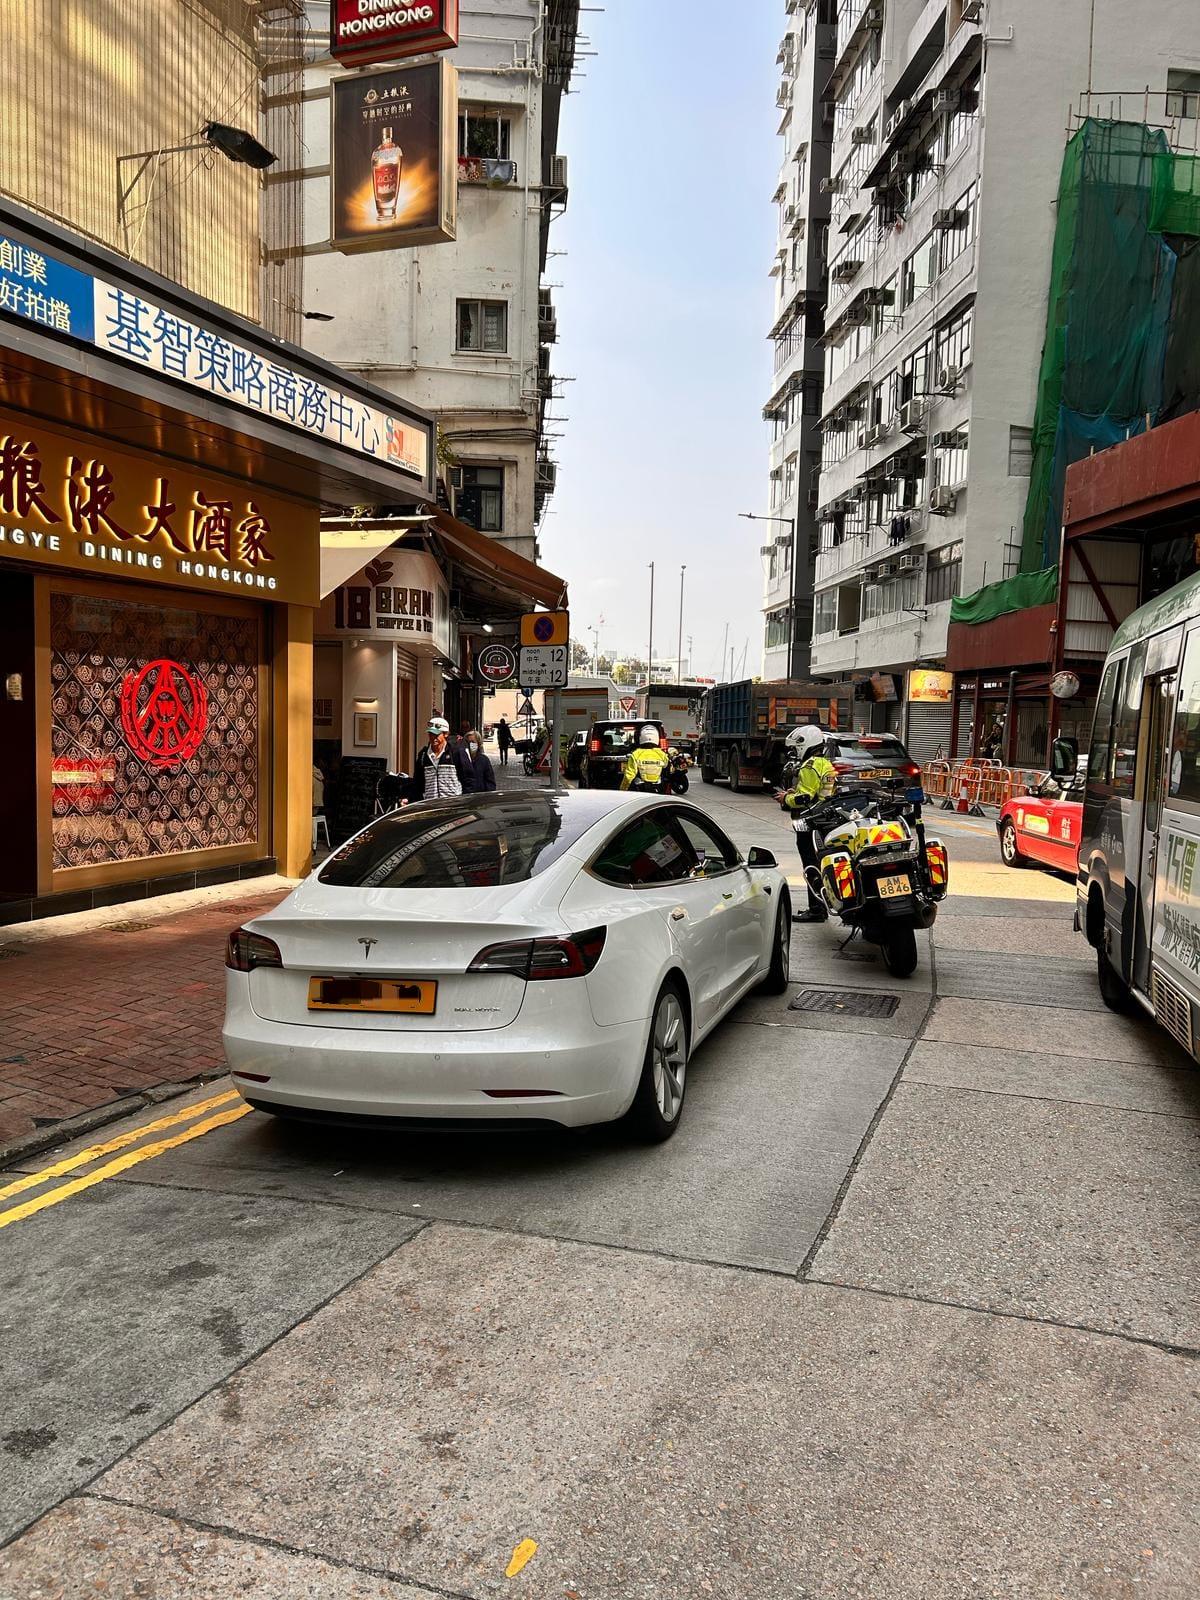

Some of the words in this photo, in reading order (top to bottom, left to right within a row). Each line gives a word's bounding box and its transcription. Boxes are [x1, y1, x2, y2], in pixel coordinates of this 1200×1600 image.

[340, 5, 434, 36] HONGKONG
[106, 288, 380, 454] 基智策略商務中心
[84, 541, 163, 570] DINING
[180, 560, 277, 590] HONGKONG
[526, 656, 540, 664] 中午
[550, 648, 564, 662] 12
[522, 668, 547, 676] midnight
[549, 669, 562, 683] 12
[887, 877, 901, 886] AM
[880, 884, 910, 896] 8846
